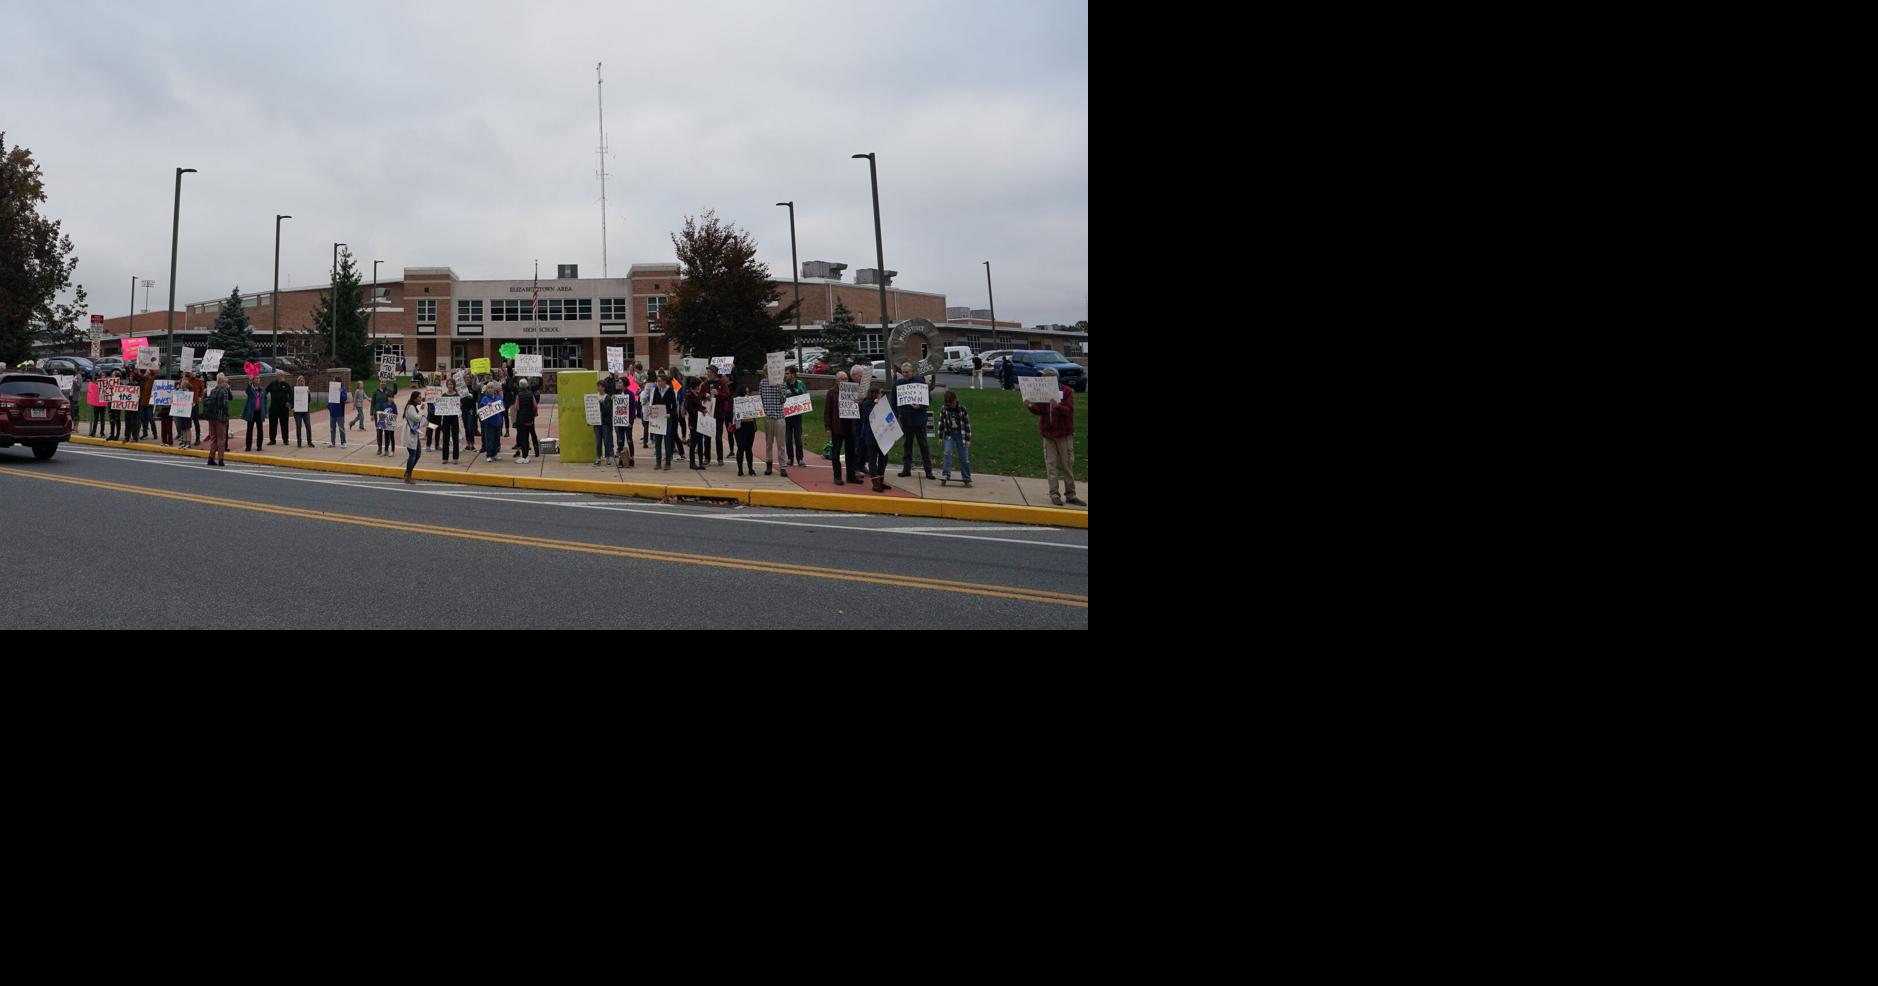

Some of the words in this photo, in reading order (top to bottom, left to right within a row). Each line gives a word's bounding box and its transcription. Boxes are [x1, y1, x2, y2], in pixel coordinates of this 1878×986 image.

[383, 355, 396, 365] FREE
[113, 386, 139, 394] TEACH
[112, 401, 138, 410] TRUTH
[613, 416, 628, 425] BANS
